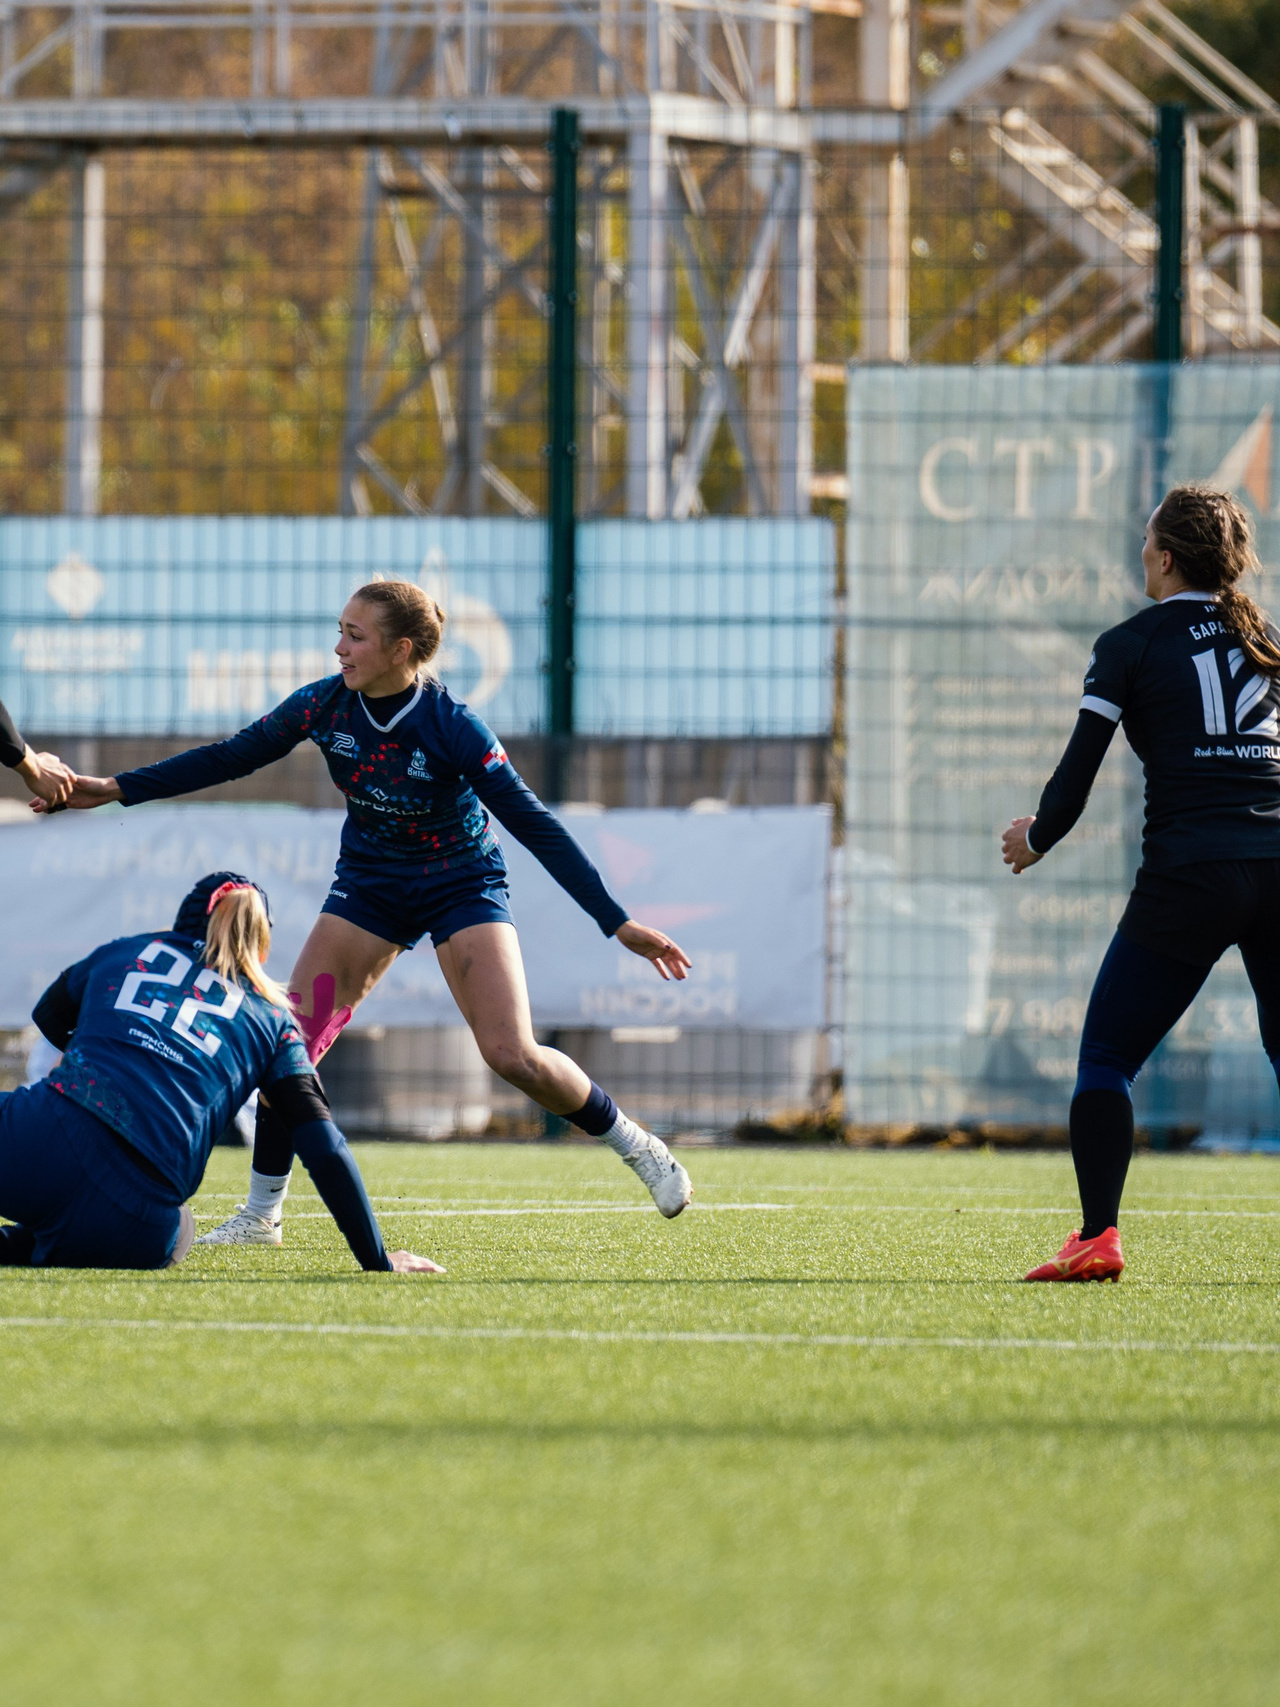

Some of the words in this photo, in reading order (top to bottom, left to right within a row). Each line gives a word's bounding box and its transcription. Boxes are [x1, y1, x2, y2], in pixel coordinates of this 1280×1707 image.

[1189, 619, 1236, 642] БАРА
[1191, 647, 1279, 738] 12
[330, 747, 353, 759] PATRICK
[1194, 745, 1235, 758] Red-Blue
[1234, 745, 1280, 759] WORL
[114, 941, 245, 1059] 22
